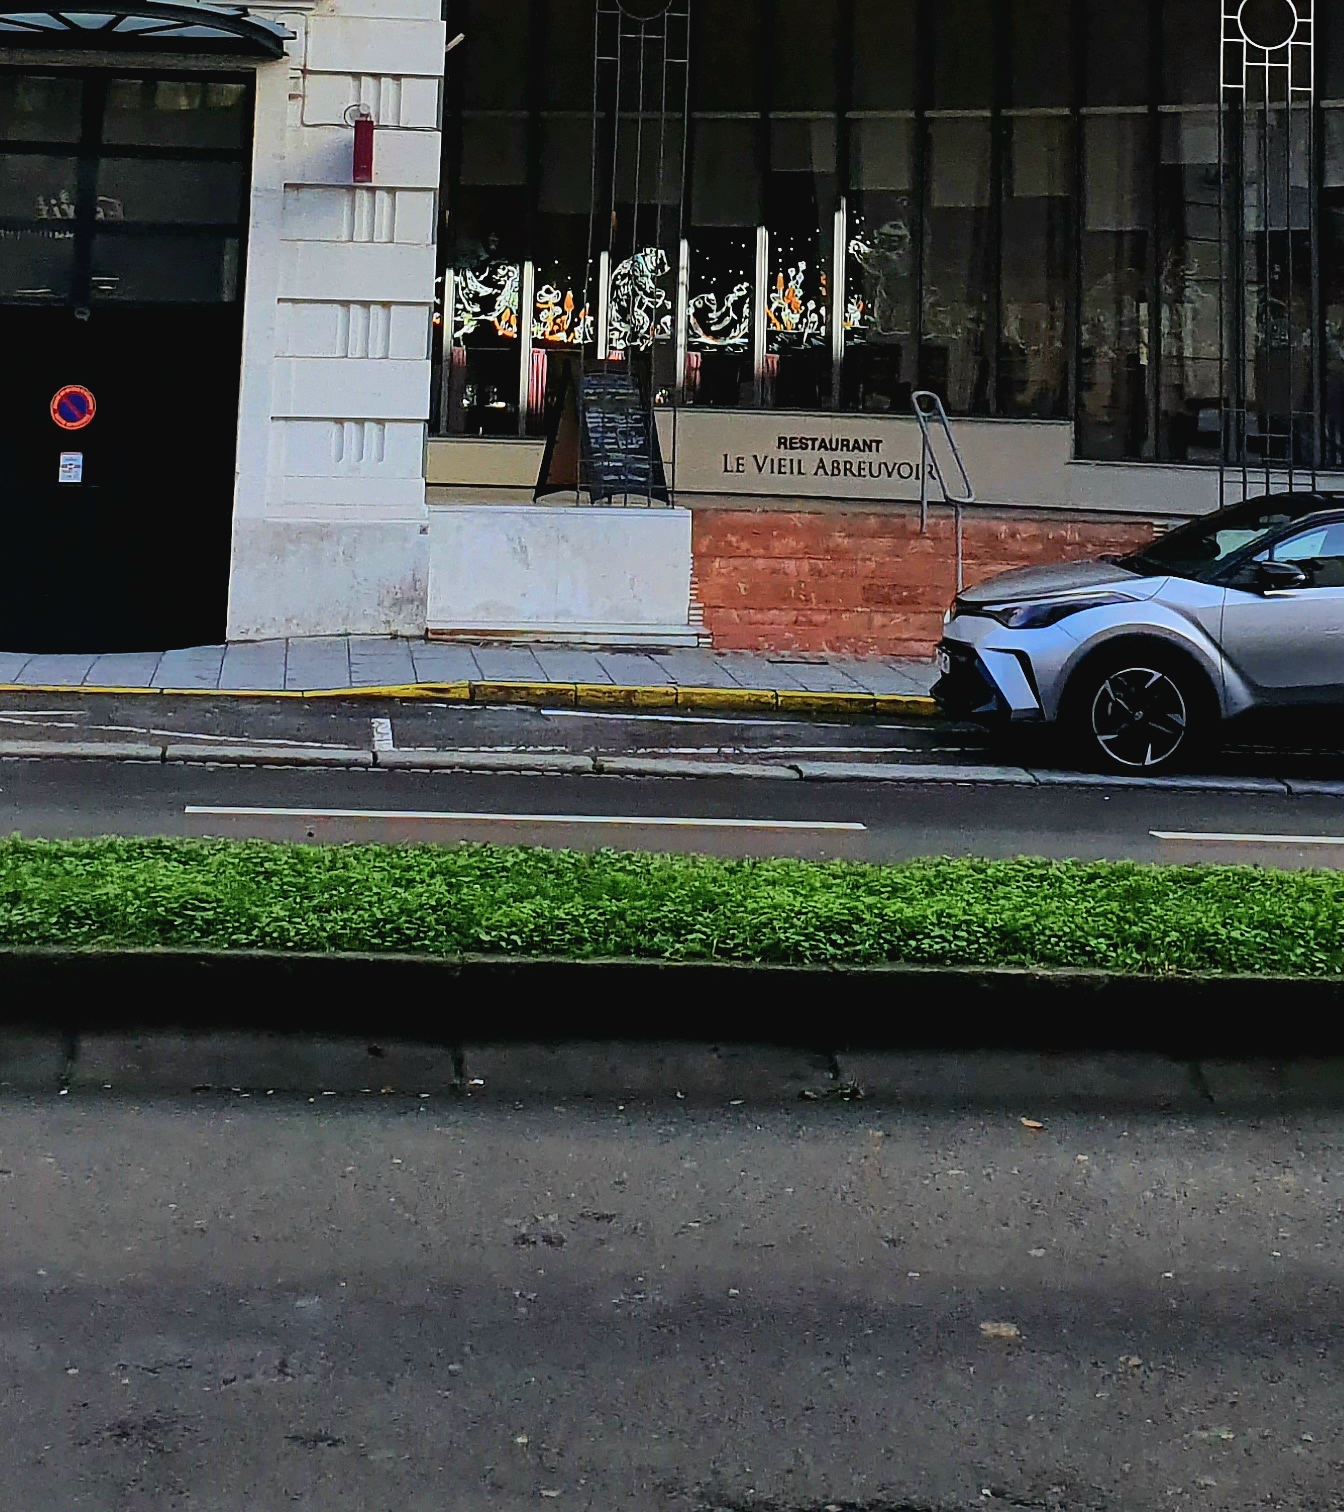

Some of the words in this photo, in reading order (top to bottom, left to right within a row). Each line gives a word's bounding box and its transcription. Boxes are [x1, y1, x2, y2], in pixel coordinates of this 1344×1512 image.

[776, 435, 884, 454] RESTAURANT
[722, 453, 746, 474] LE
[752, 454, 806, 476] VIEIL
[813, 457, 937, 481] ABREUVOIR
